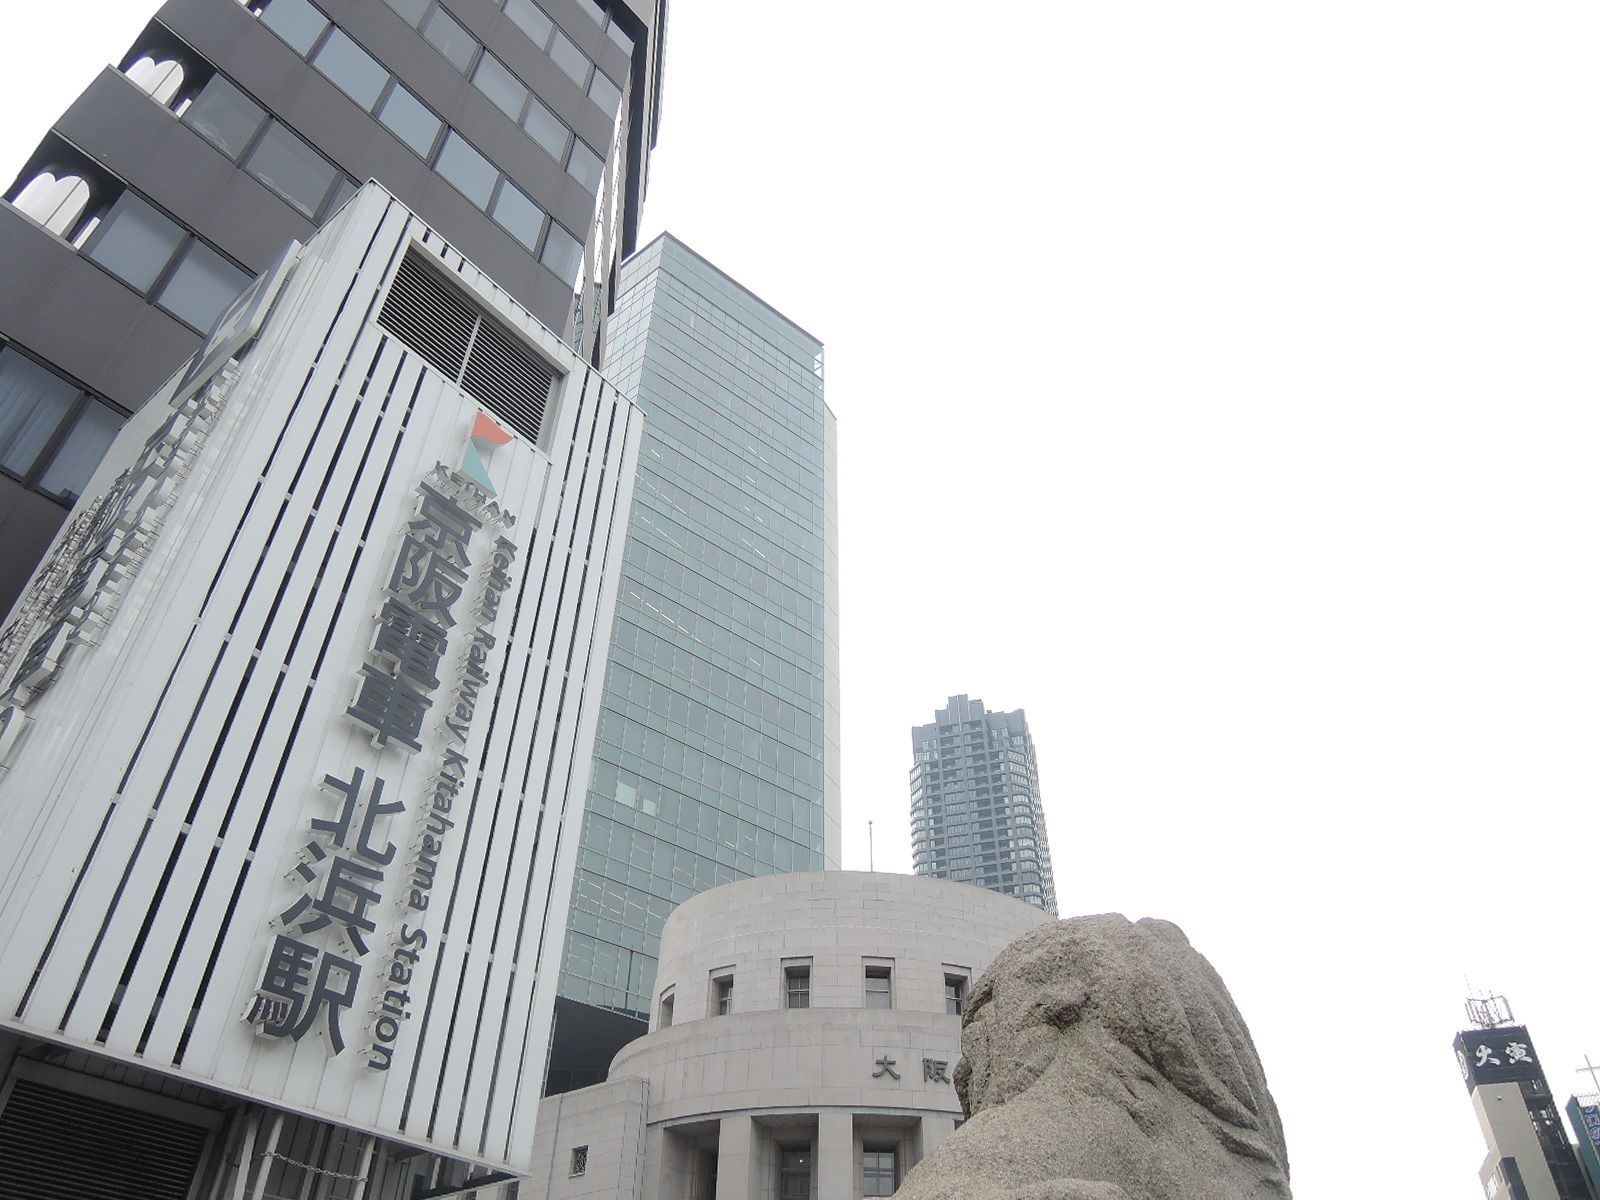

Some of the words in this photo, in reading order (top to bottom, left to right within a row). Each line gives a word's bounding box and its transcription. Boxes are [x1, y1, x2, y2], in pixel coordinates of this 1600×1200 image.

[341, 480, 483, 752] 京阪電車
[474, 534, 518, 625] Keihan
[442, 626, 497, 745] Railway
[406, 747, 469, 912] Kitahama
[240, 766, 406, 1057] 北浜駅
[365, 923, 428, 1072] Station
[872, 1055, 951, 1084] 大阪
